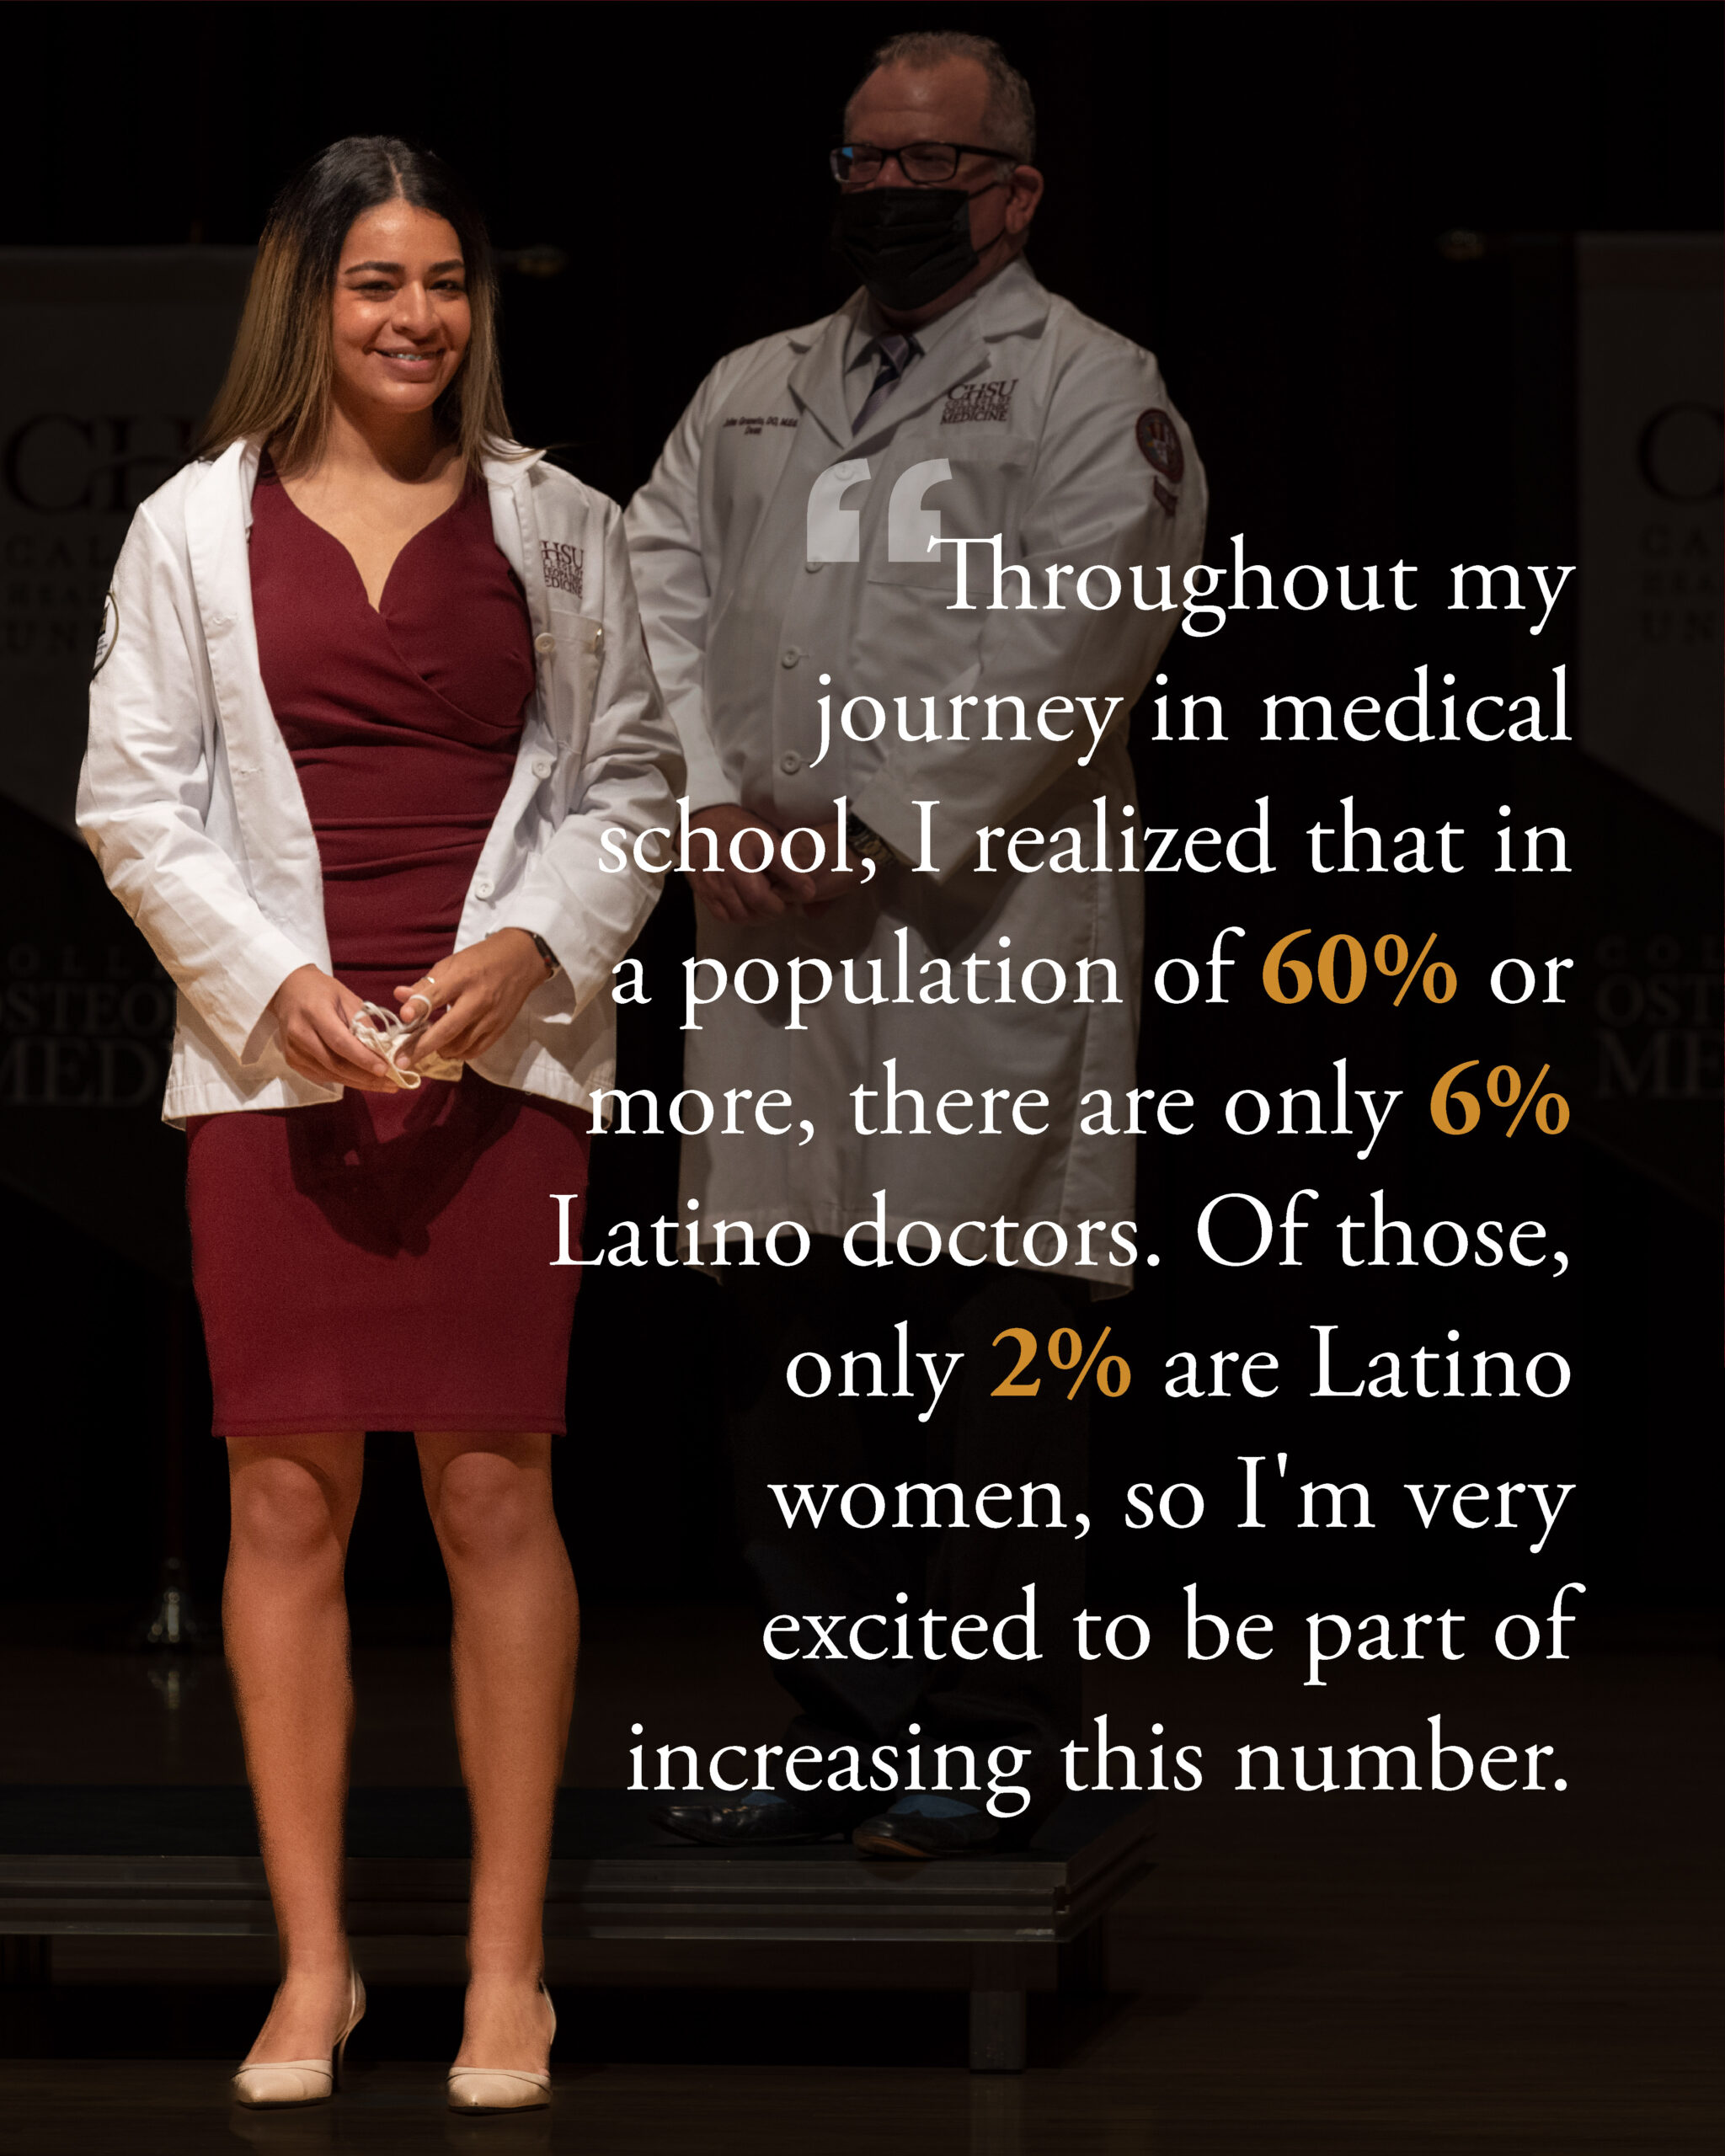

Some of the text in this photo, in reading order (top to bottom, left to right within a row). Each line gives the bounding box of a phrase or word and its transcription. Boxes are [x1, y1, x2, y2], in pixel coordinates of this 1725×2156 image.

[948, 379, 1019, 400] CHSU
[540, 540, 585, 570] HSU
[543, 576, 583, 600] EDICINE
[0, 982, 170, 1037] STEO
